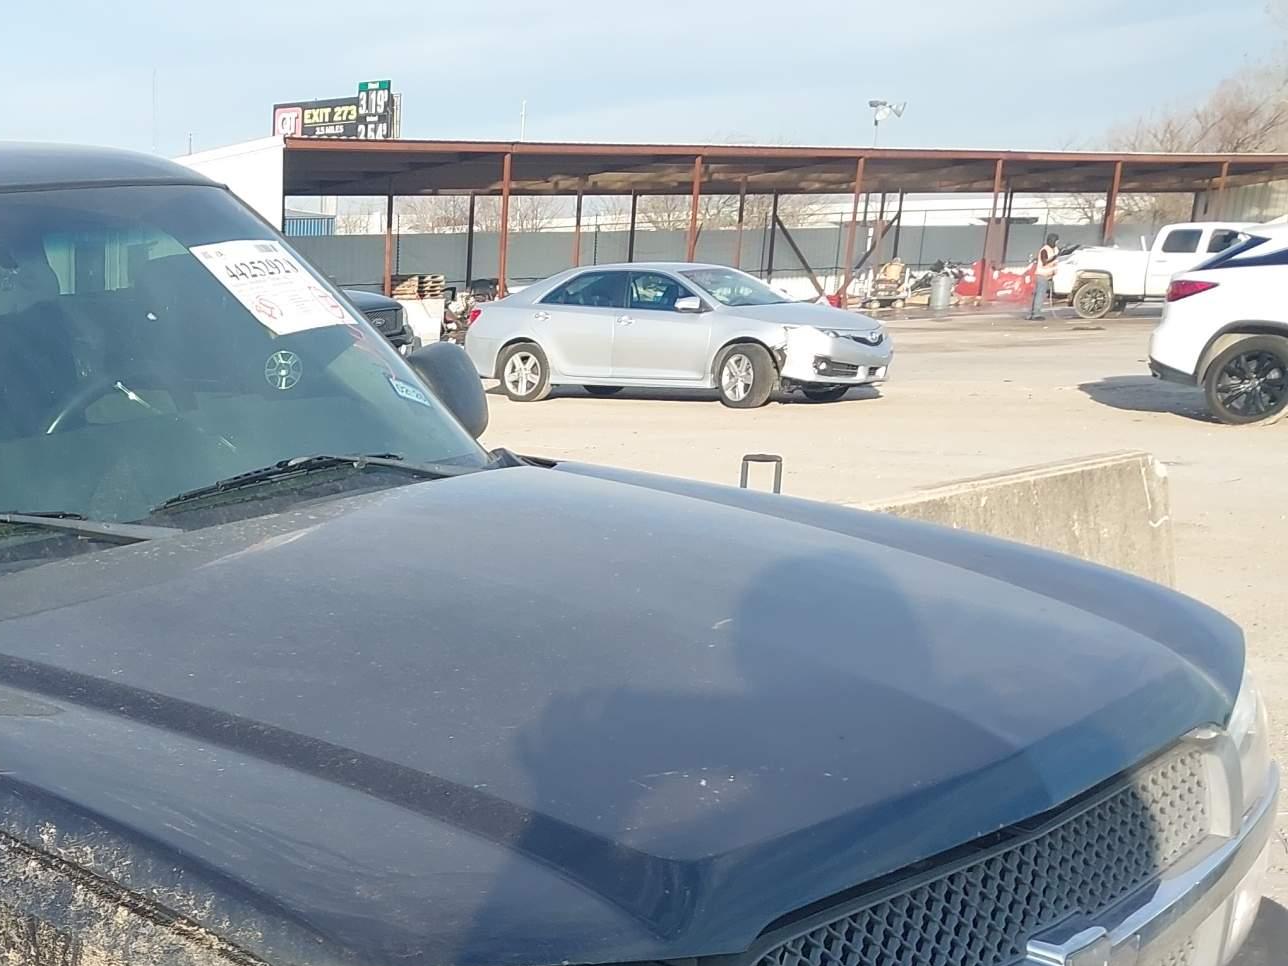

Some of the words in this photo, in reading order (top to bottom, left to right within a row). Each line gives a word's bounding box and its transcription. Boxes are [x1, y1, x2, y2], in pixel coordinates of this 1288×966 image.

[278, 111, 298, 135] QT
[304, 107, 331, 123] EXIT
[333, 105, 357, 121] 273
[325, 125, 344, 134] MILES
